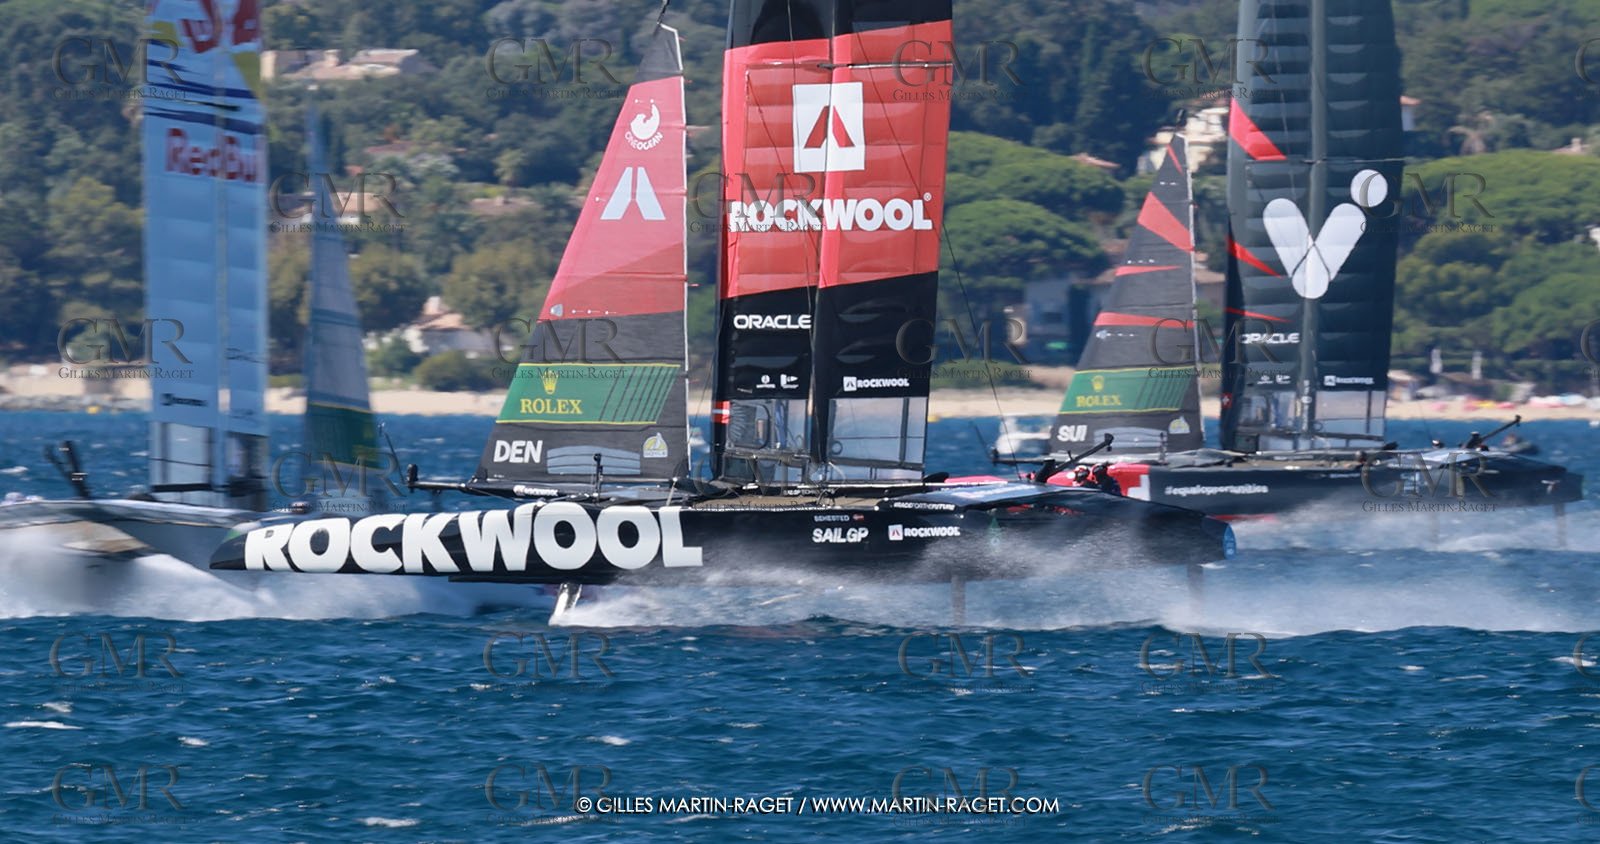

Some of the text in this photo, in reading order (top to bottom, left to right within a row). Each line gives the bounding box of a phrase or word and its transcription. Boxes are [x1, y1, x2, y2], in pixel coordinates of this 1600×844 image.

[733, 314, 812, 330] ORACLE
[857, 378, 910, 388] ROCKWOOL
[520, 398, 583, 415] ROLEX
[1076, 395, 1122, 408] ROLEX
[1057, 425, 1088, 442] SUI
[493, 440, 543, 463] DEN
[244, 501, 704, 574] ROCKWOOL
[812, 527, 869, 543] SAILGP
[904, 526, 961, 537] ROCKWOOL
